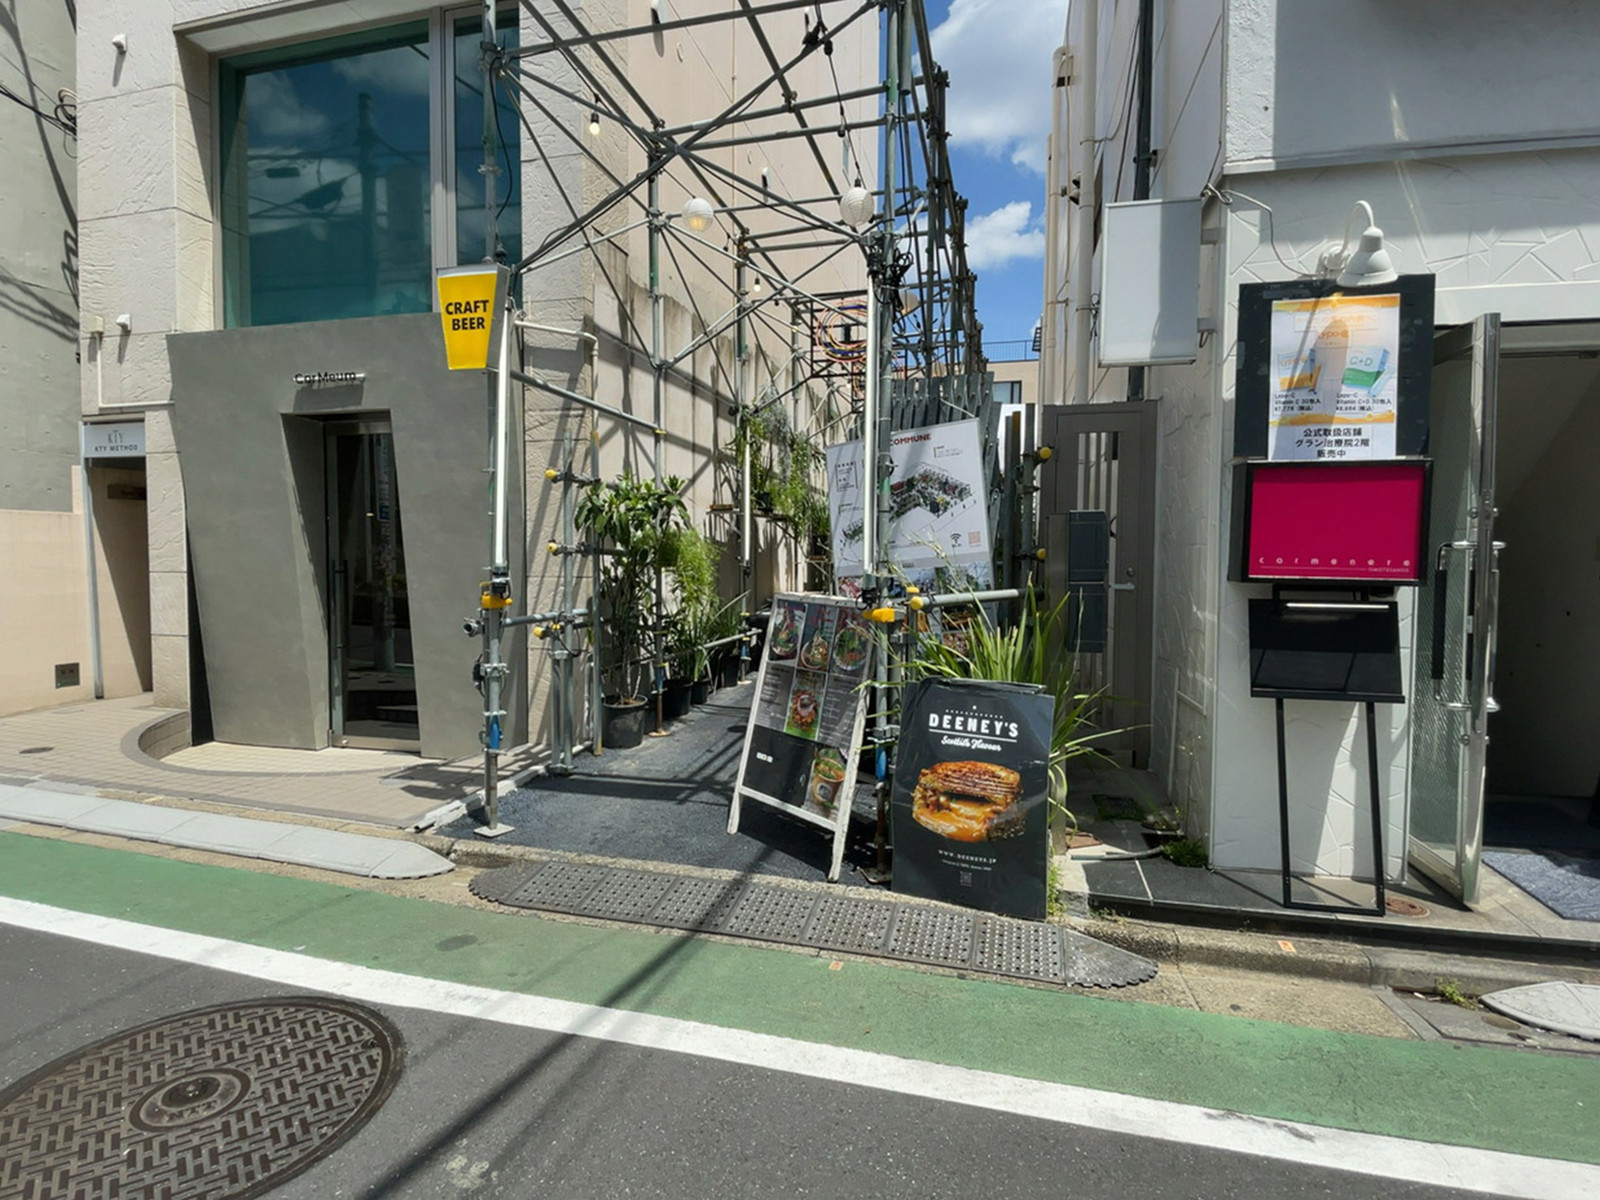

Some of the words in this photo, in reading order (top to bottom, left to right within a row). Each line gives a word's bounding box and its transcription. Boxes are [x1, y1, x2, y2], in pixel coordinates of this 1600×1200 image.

[445, 300, 490, 315] CRAFT
[452, 317, 486, 331] BEER
[295, 371, 356, 384] CorMeum
[108, 430, 125, 444] KTY
[1303, 427, 1362, 437] 公式取扱店舗
[110, 444, 138, 452] METHOD
[1295, 438, 1370, 448] グラン治療院2階
[1317, 449, 1346, 458] 販売中
[928, 713, 1018, 737] DEENEY'S
